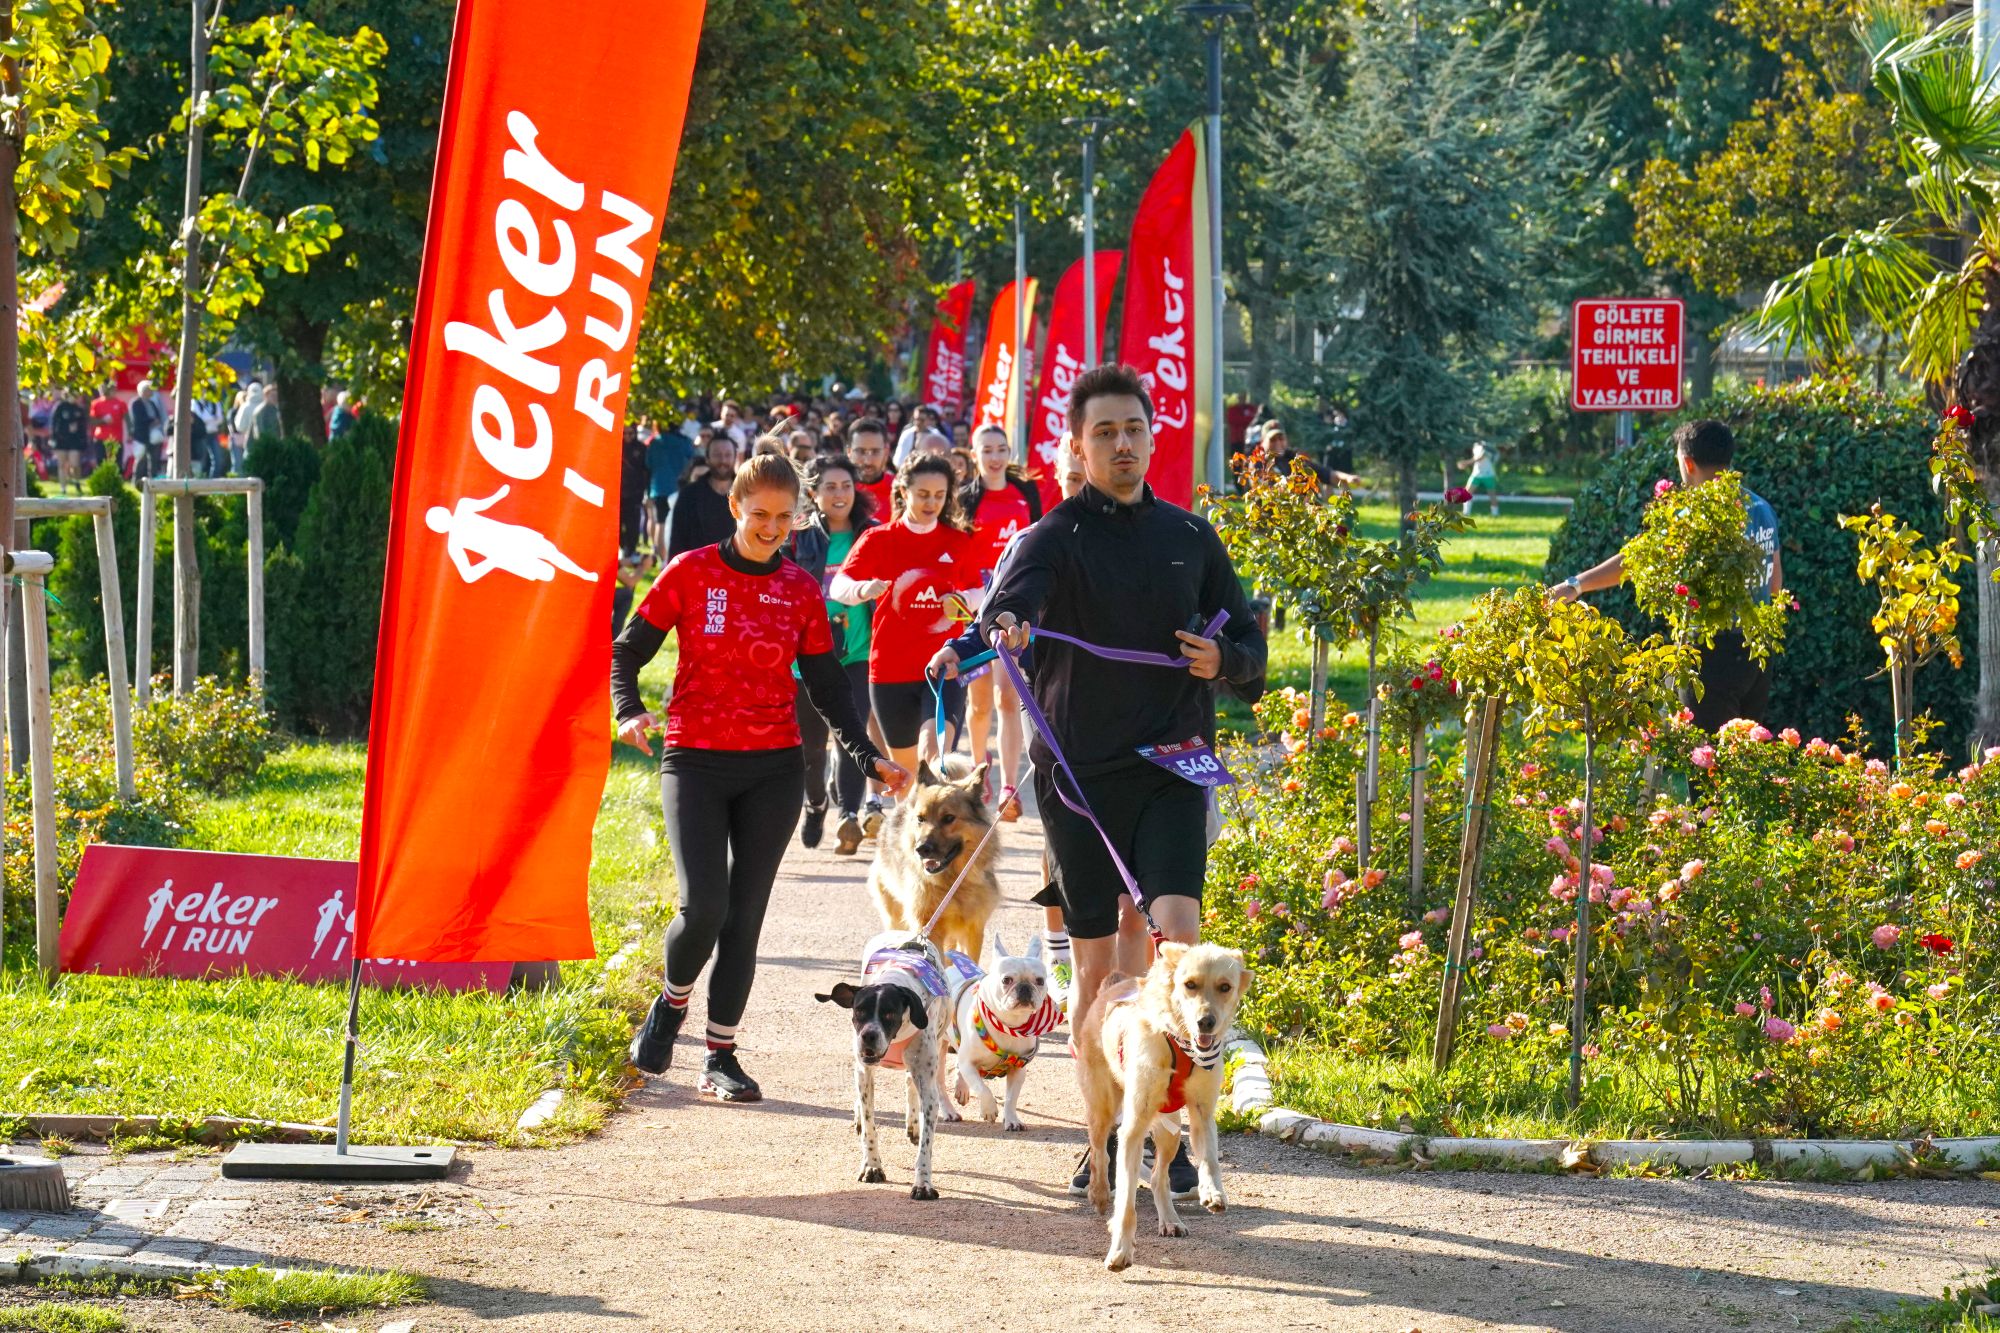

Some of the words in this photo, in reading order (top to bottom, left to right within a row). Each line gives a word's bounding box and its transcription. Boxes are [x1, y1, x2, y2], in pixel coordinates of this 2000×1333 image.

[444, 110, 584, 481] eker
[574, 190, 654, 432] RUN
[1594, 304, 1665, 324] GÖLETE
[1593, 325, 1665, 344] GİRMEK
[1581, 344, 1676, 365] TEHLİKELİ
[928, 340, 950, 400] eker
[988, 342, 1012, 417] eker
[1616, 369, 1640, 385] VE
[1041, 343, 1078, 438] eker
[1582, 389, 1673, 405] YASAKTIR
[563, 467, 605, 507] I
[704, 625, 725, 633] RUZ
[1176, 755, 1219, 776] 548
[174, 882, 279, 926] eker
[161, 926, 177, 950] I
[182, 927, 254, 955] RUN
